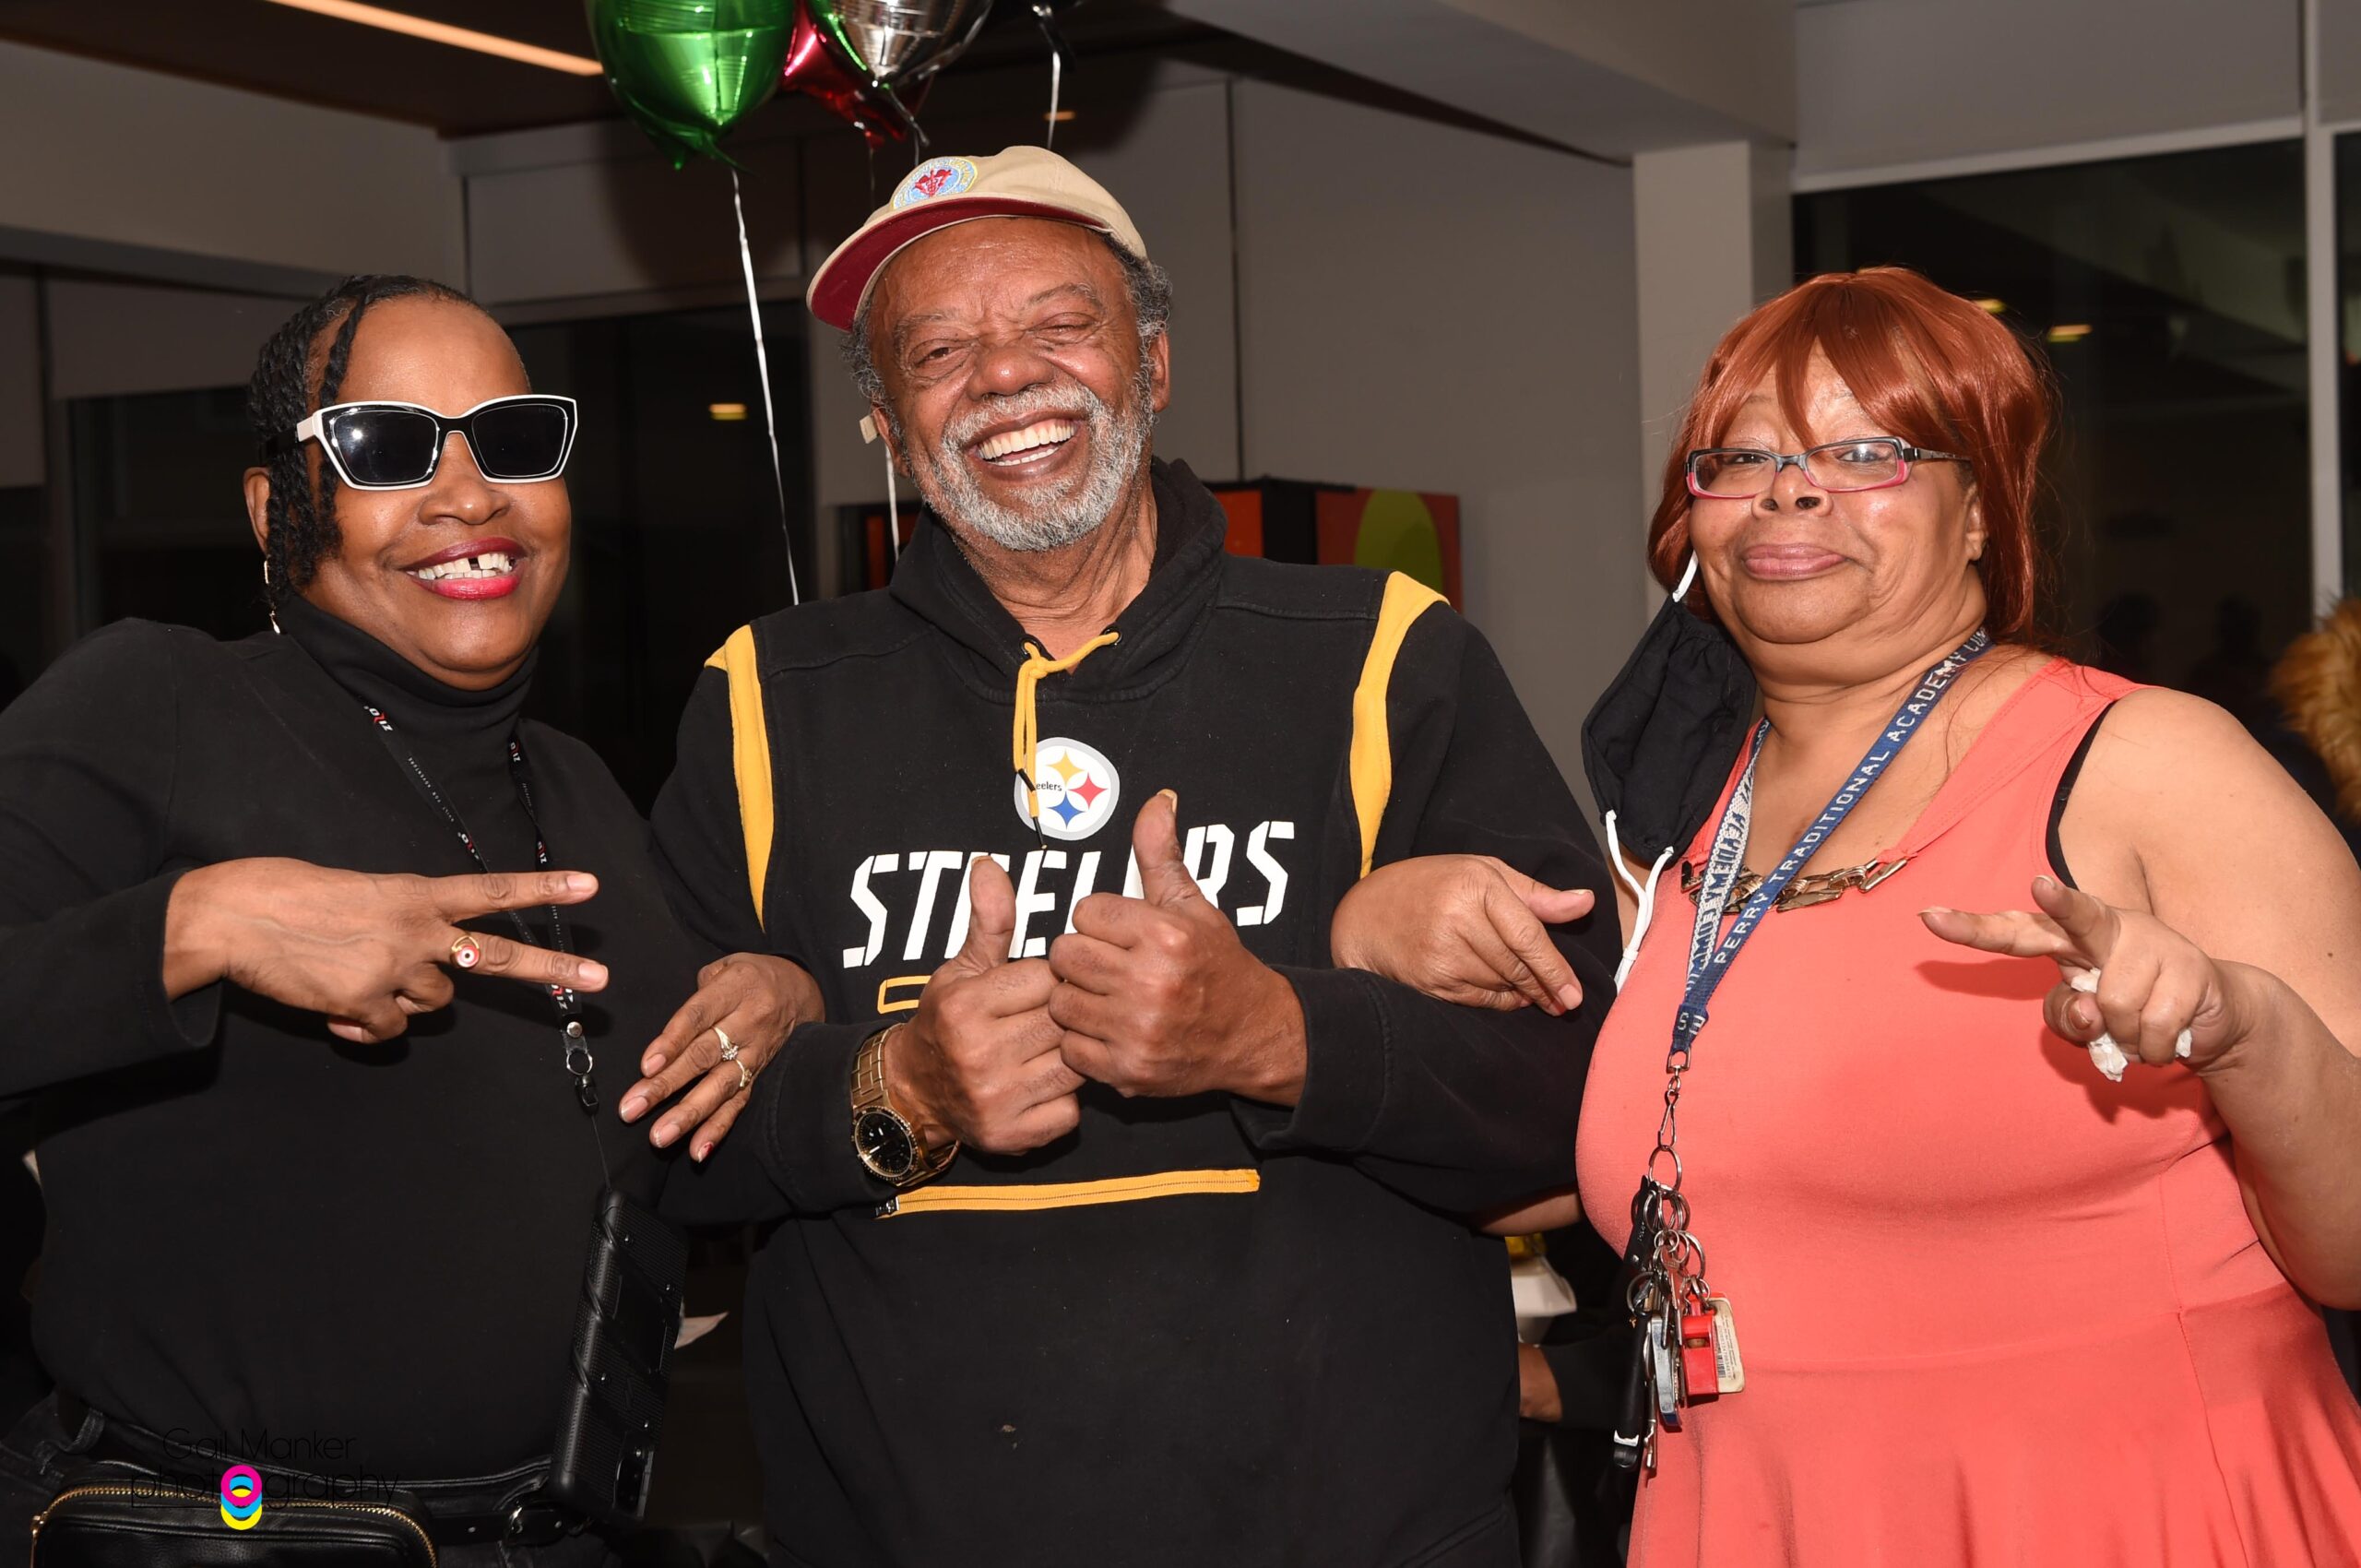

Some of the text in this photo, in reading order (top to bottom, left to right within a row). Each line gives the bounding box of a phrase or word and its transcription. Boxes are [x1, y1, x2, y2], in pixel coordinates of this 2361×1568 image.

[1036, 779, 1062, 791] eelers
[1714, 892, 1768, 965] PERRY
[1769, 749, 1890, 885] TRADITIONAL
[1887, 651, 1967, 742] ACADEMY
[843, 821, 1295, 968] STELRS
